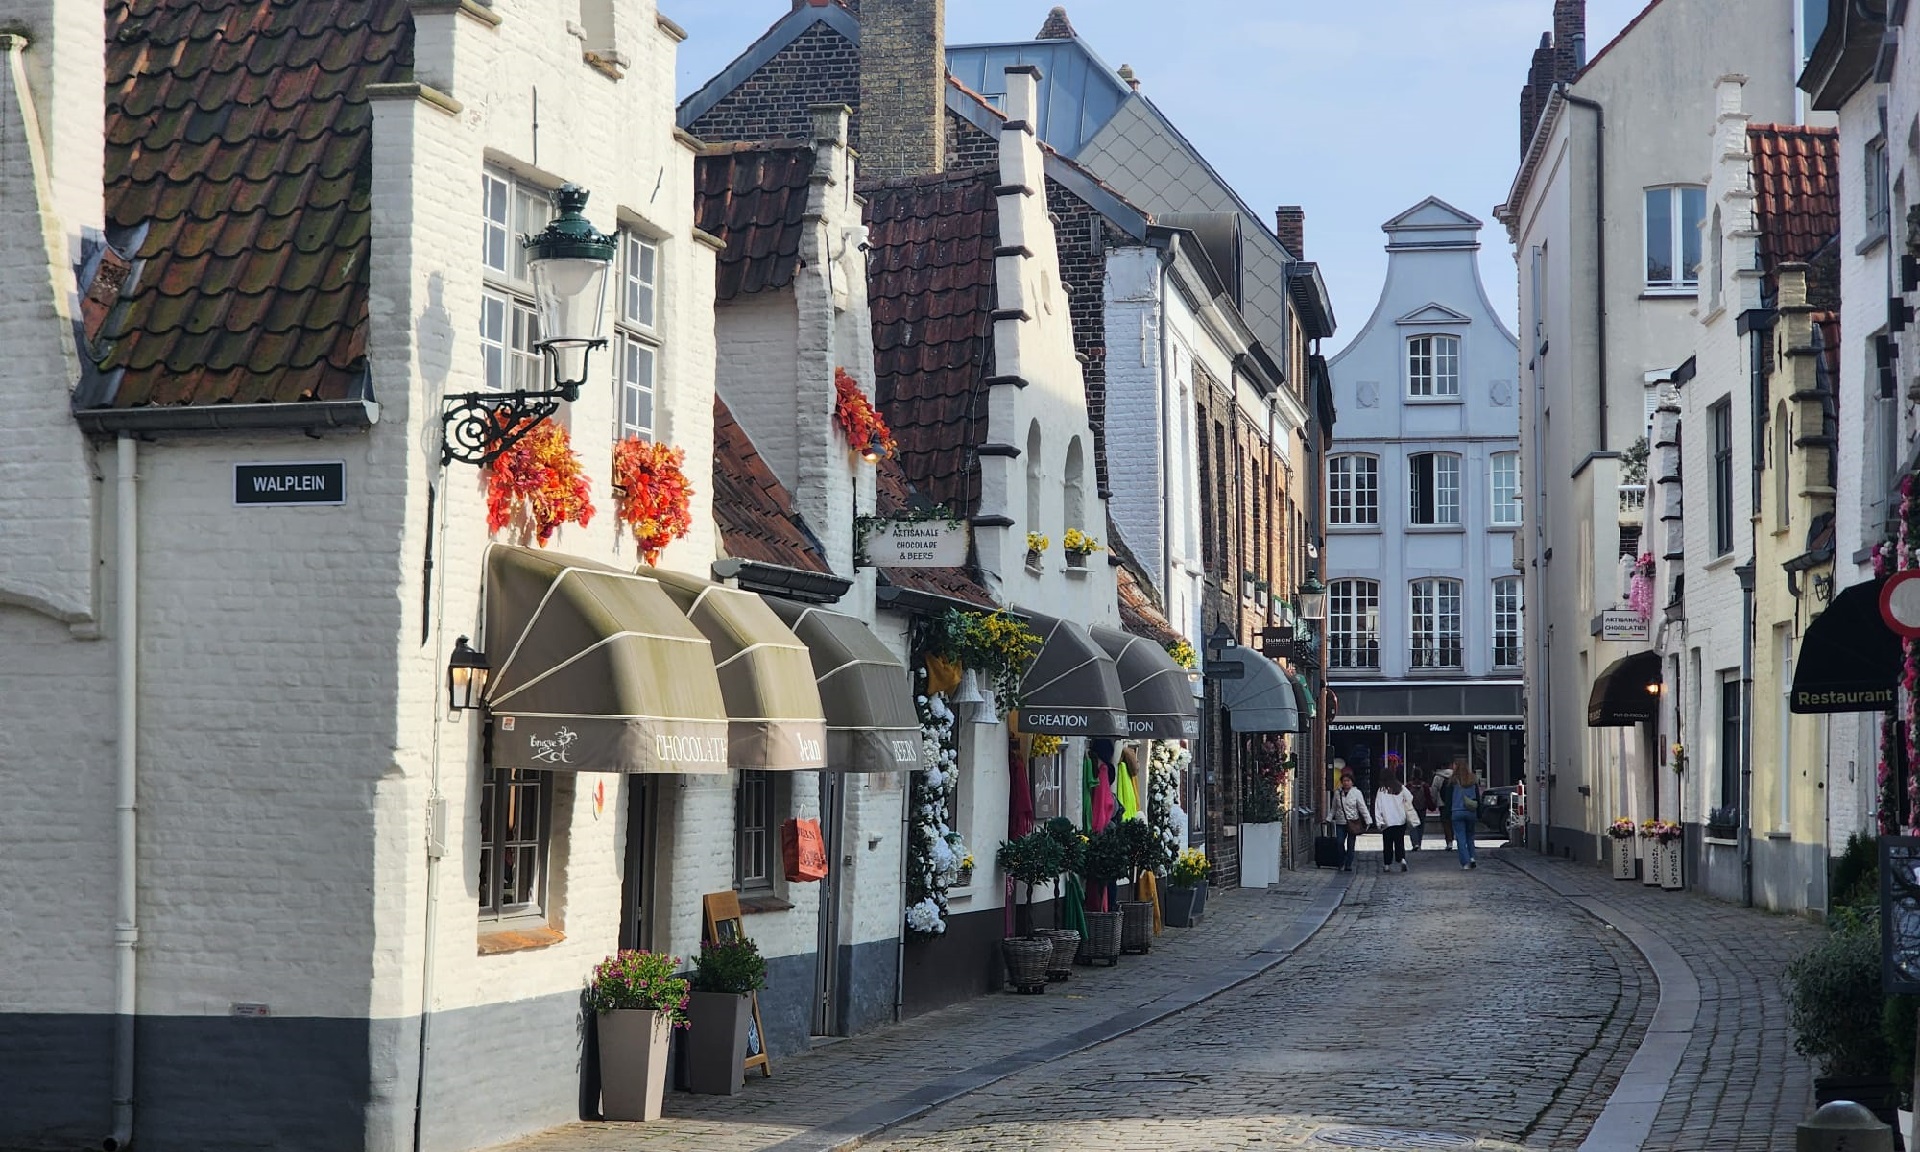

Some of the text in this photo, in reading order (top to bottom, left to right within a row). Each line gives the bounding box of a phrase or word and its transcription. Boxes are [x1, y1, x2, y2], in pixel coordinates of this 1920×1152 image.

[253, 475, 325, 492] WALPLEIN
[892, 528, 939, 538] ARTISANALE
[896, 541, 938, 549] CHOCOLADE
[899, 551, 934, 560] & BEERS
[1798, 689, 1894, 706] Restaurant
[1028, 714, 1088, 727] CREATION
[656, 733, 728, 763] CHOCOLATE
[798, 732, 822, 762] Jean
[892, 740, 917, 762] BEERS
